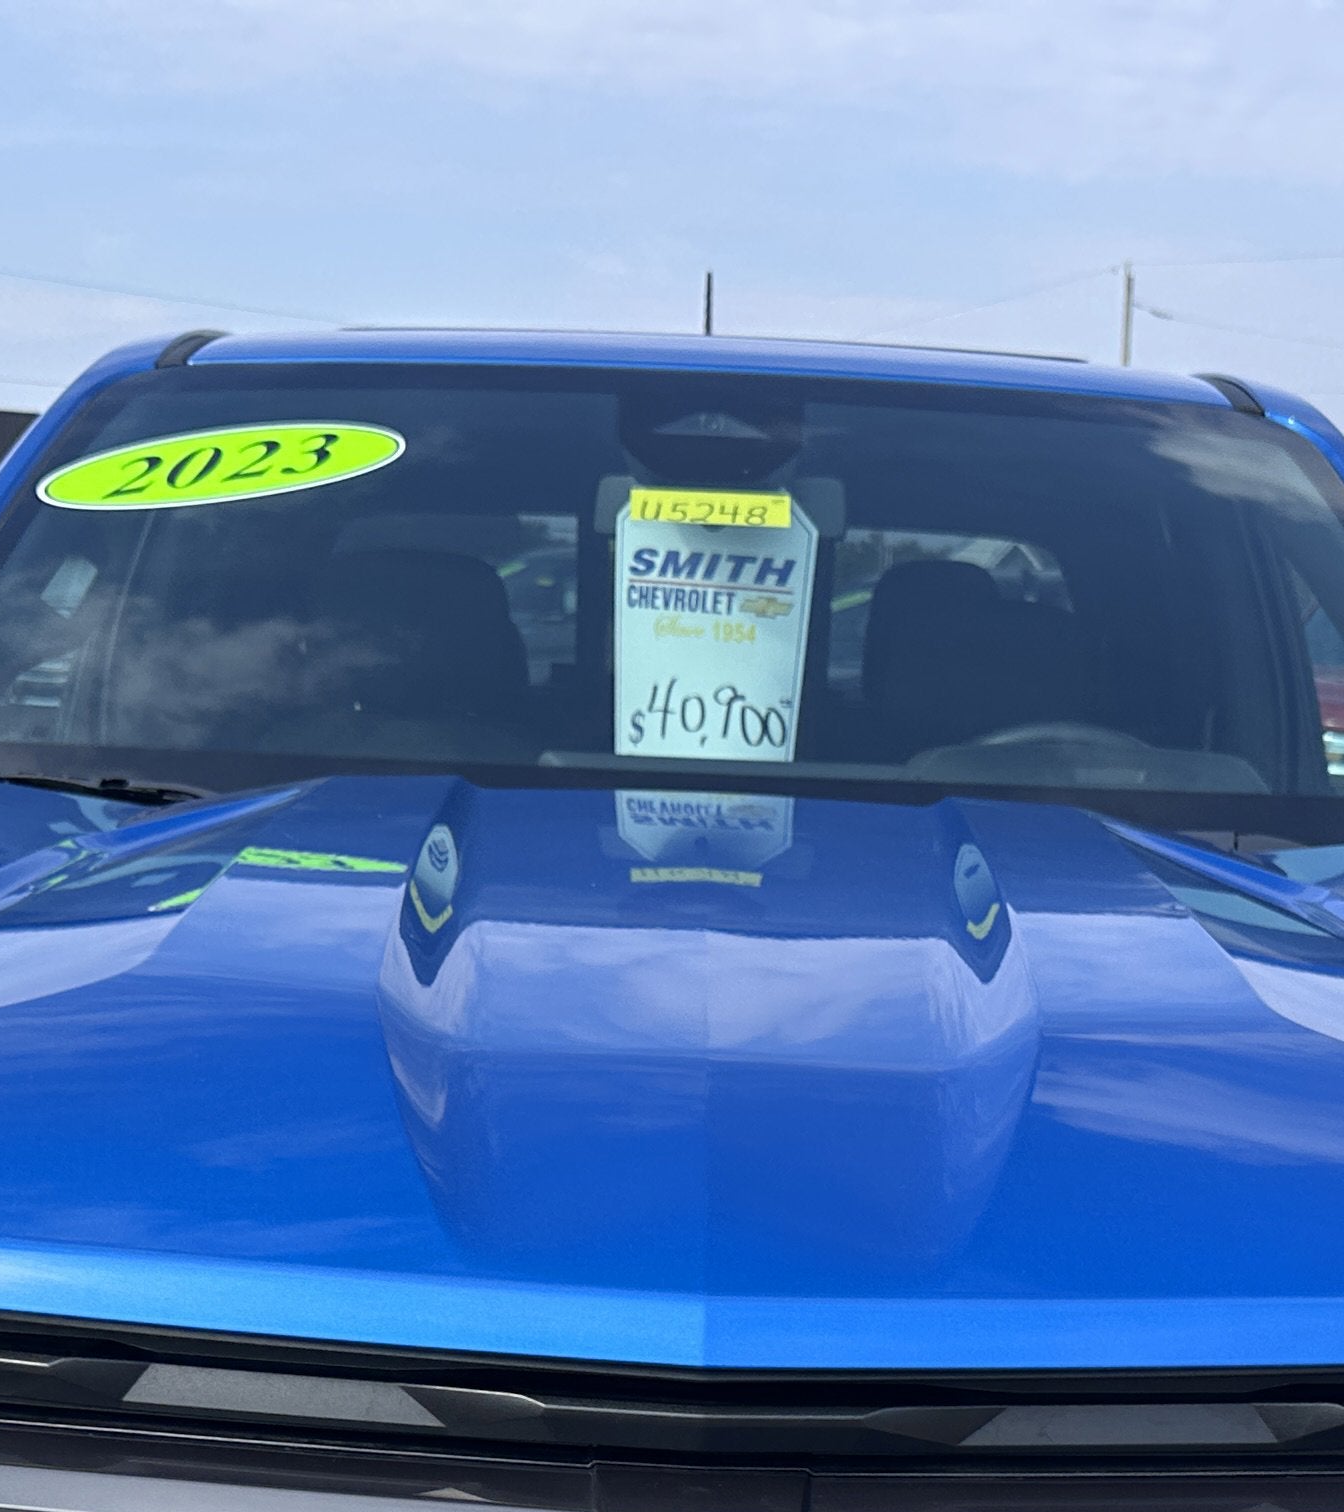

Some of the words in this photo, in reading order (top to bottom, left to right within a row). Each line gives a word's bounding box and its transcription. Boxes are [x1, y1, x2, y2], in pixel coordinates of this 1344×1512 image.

[102, 433, 340, 499] 2023
[639, 497, 768, 526] U5248
[628, 547, 797, 587] SMITH
[627, 584, 736, 616] CHEVROLET
[712, 619, 756, 645] 1954
